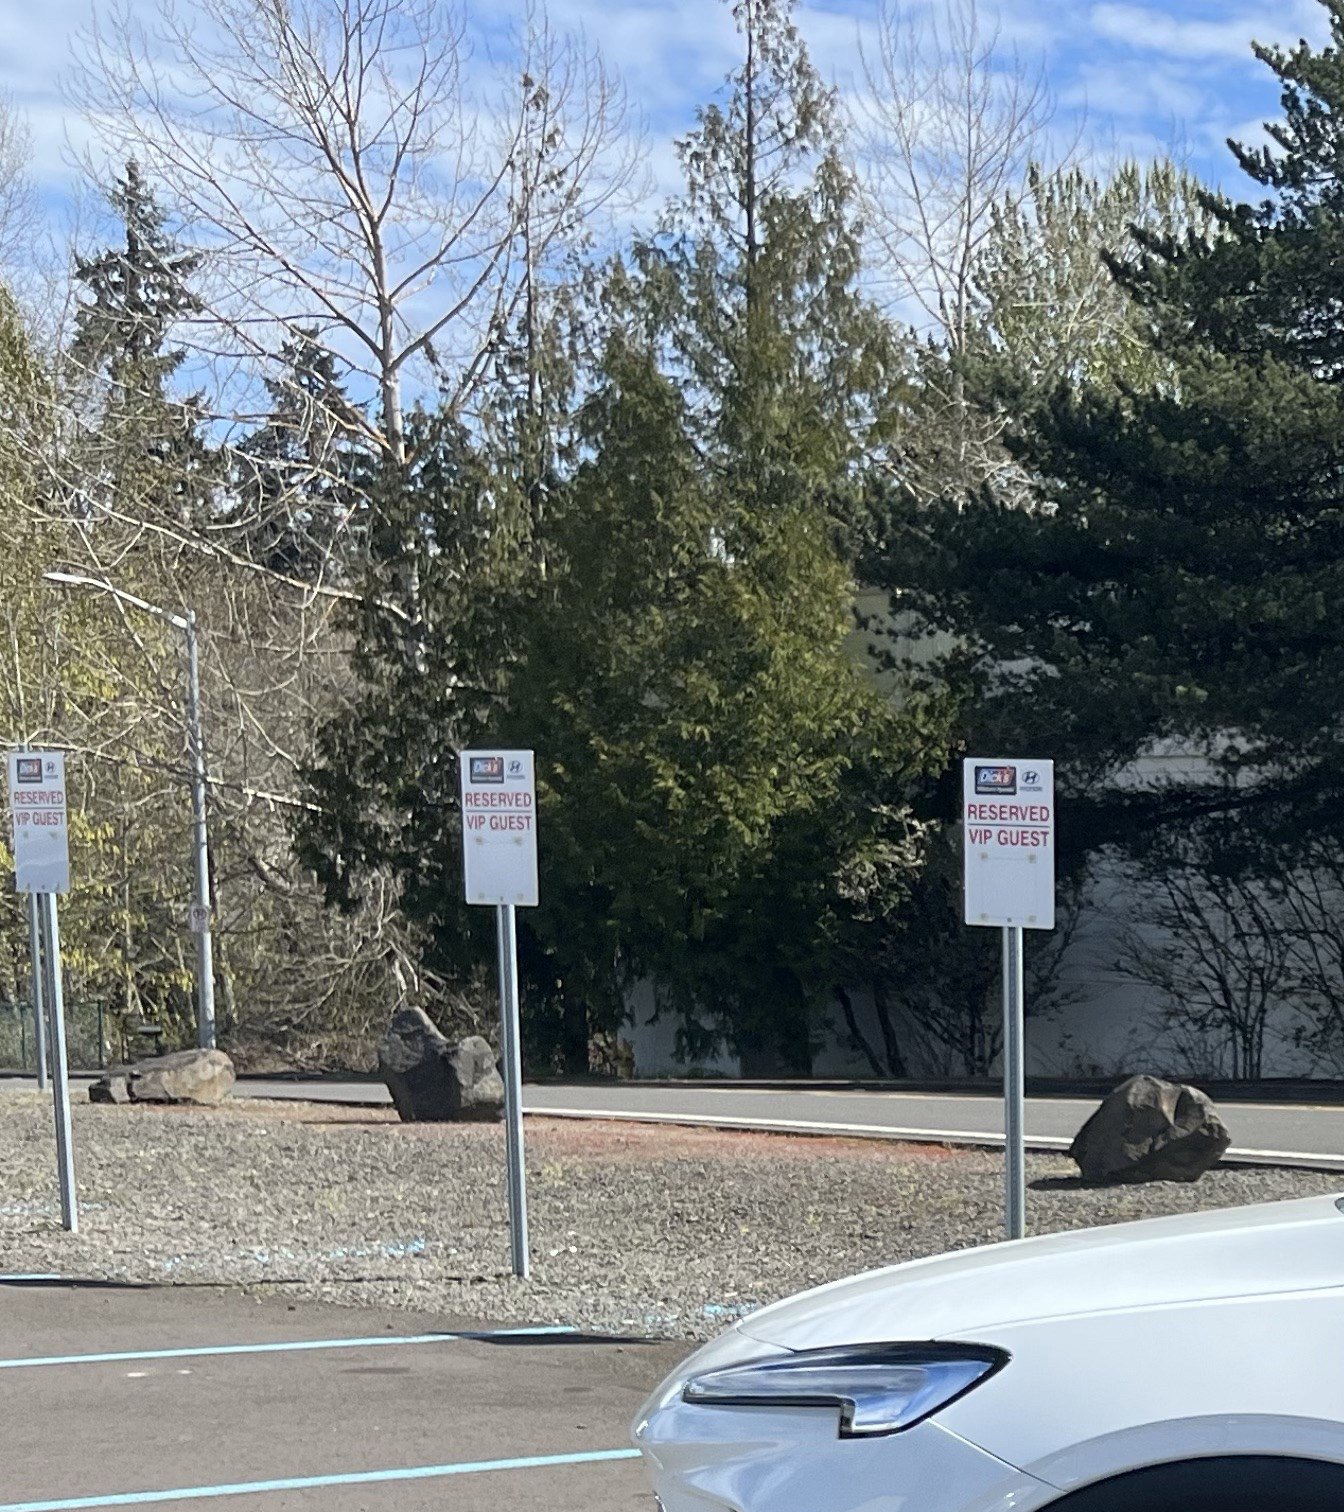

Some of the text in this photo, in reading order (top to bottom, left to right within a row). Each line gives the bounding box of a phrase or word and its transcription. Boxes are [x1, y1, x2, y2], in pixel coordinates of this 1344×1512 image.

[14, 791, 63, 805] RESERVED
[465, 792, 532, 808] RESERVED
[15, 811, 65, 826] VIP GUEST
[967, 804, 1050, 822] RESERVED
[466, 815, 532, 831] VIP GUEST
[968, 829, 1050, 847] VIP GUEST
